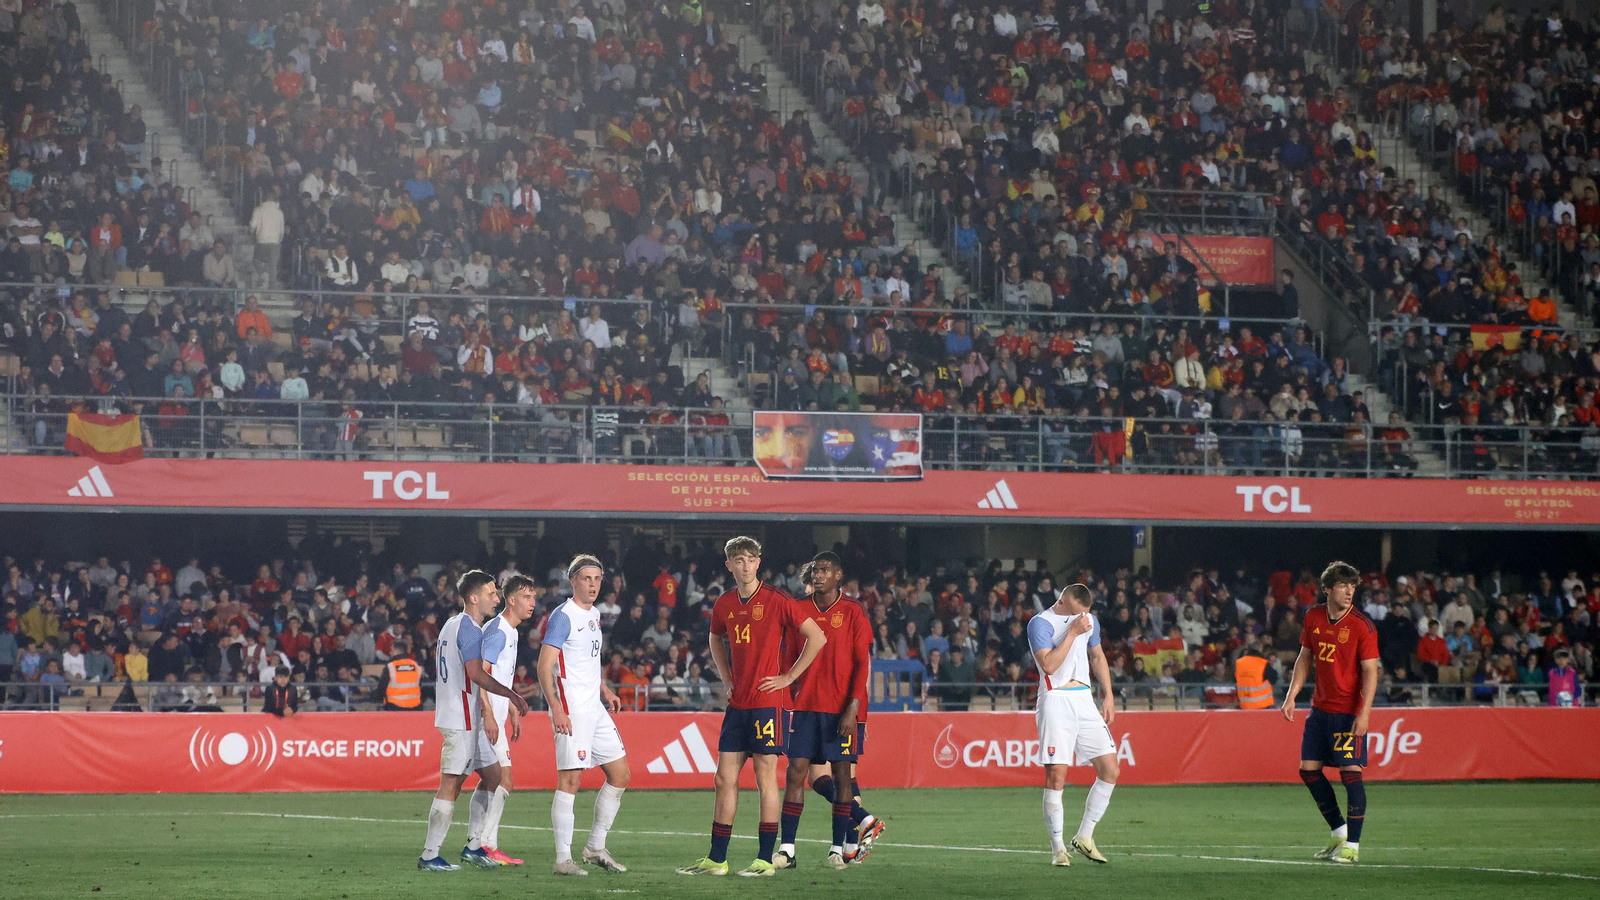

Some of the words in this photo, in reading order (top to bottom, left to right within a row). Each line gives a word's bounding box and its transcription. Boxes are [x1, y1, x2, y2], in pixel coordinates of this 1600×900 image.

[1210, 246, 1267, 256] ESPAÑOLA
[628, 471, 709, 482] SELECCIÓN
[363, 470, 450, 500] TCL
[671, 485, 690, 494] DE
[695, 484, 750, 495] FÚTBOL
[1466, 486, 1538, 495] SELECCIÓN
[684, 498, 734, 507] SUB-21
[1235, 485, 1312, 513] TCL
[1504, 498, 1521, 507] DE
[1525, 497, 1574, 508] FÚTBOL
[1515, 510, 1560, 519] SUB-21
[1135, 531, 1145, 546] 17
[666, 582, 675, 595] 9
[734, 623, 751, 644] 14
[590, 639, 600, 657] 19
[1318, 641, 1337, 663] 22
[754, 718, 775, 740] 14
[282, 739, 348, 757] STAGE
[354, 739, 424, 757] FRONT
[1333, 732, 1355, 751] 22
[963, 732, 1136, 768] CABRÁ
